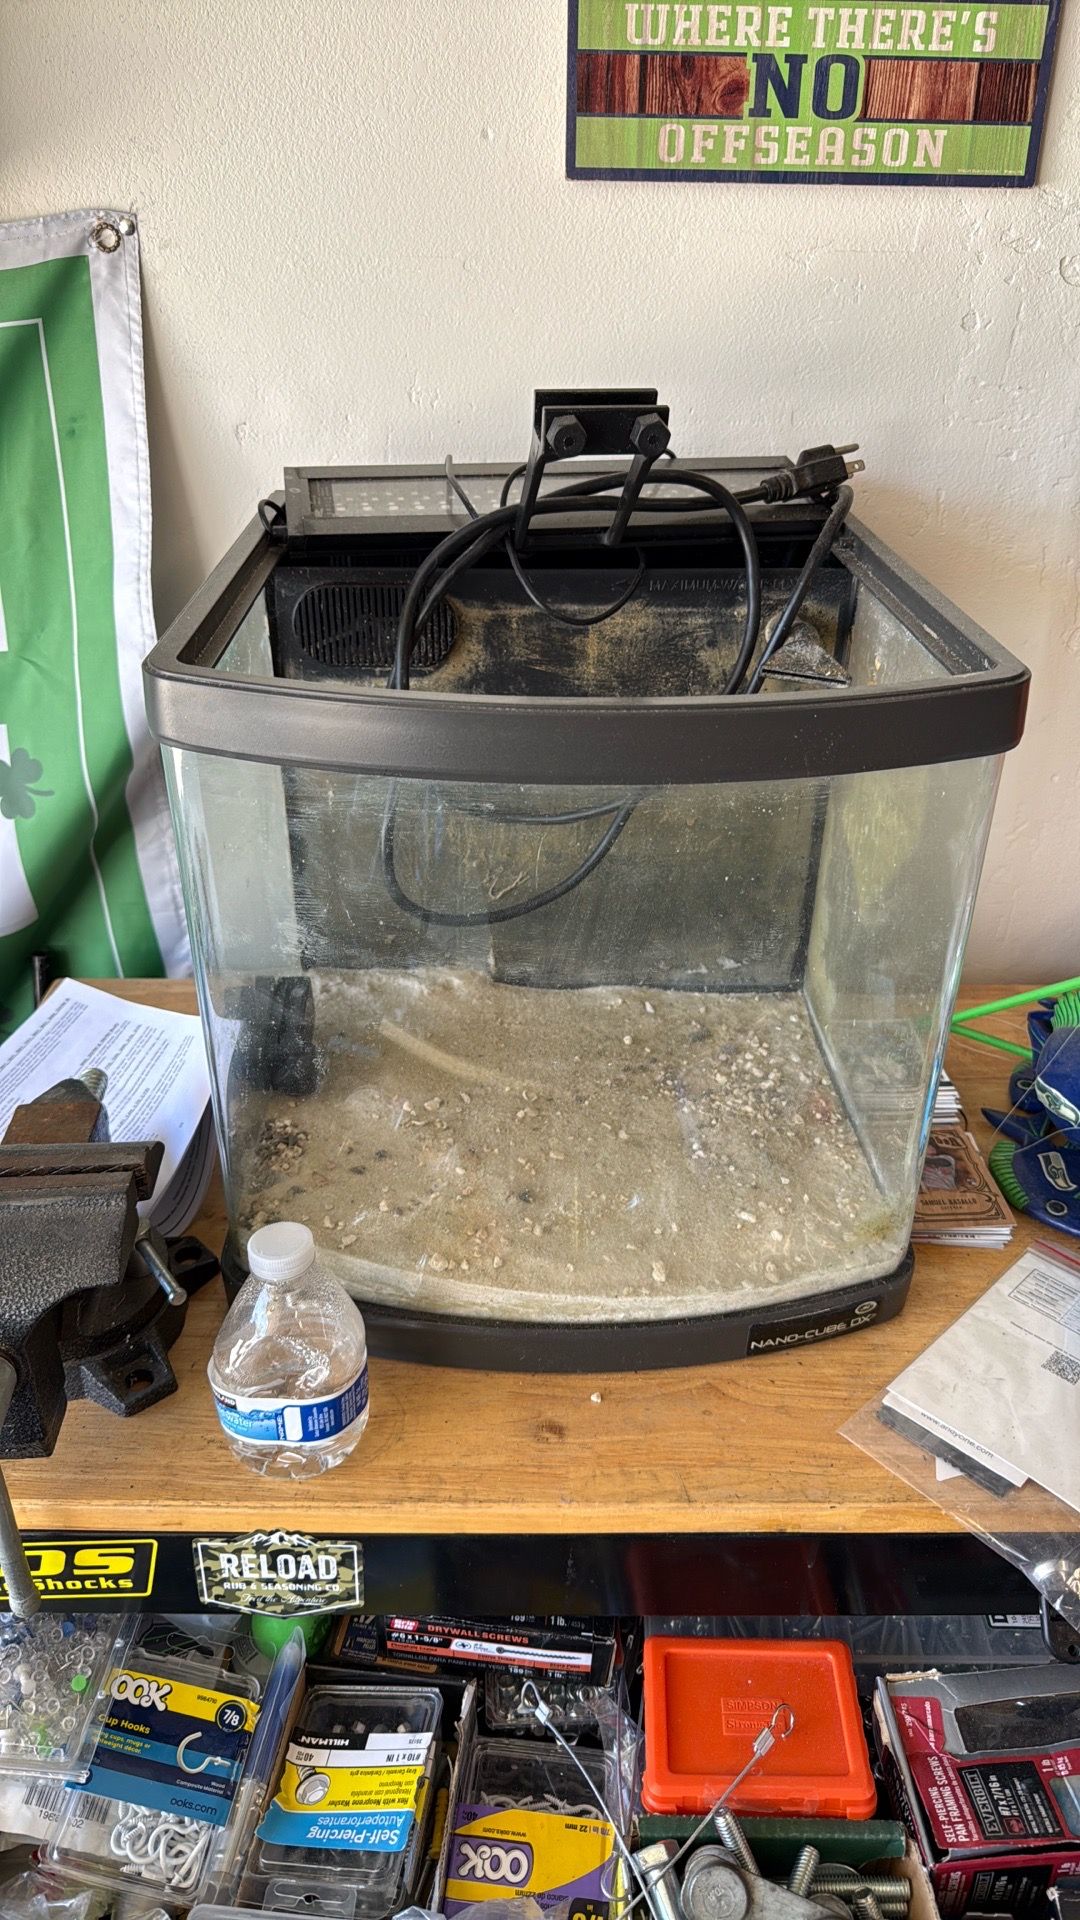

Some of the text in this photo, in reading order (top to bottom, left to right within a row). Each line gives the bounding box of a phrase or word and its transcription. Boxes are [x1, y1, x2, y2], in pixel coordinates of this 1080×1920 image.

[625, 2, 999, 53] WHERE THERE'S
[748, 53, 860, 119] NO
[658, 123, 947, 168] OFFSEASON
[750, 1313, 877, 1350] NANO-CUBE DX
[219, 1553, 338, 1580] RELOAD
[223, 1582, 247, 1591] RUB
[250, 1582, 257, 1591] &
[261, 1583, 322, 1592] SEASONING
[427, 1624, 480, 1637] DRYWALL
[482, 1631, 529, 1644] SCREWS
[110, 1673, 172, 1711] OOK
[98, 1713, 151, 1735] Cup Hooks
[223, 1708, 240, 1726] 7/8
[300, 1735, 350, 1746] HILLMAN
[303, 1752, 315, 1761] 40
[386, 1754, 396, 1762] IN
[407, 1753, 421, 1761] #10
[927, 1756, 970, 1842] PAN FRAMING SCREWS
[988, 1782, 1007, 1800] 7/16
[169, 1795, 218, 1816] ooks.com
[327, 1797, 409, 1808] Hex with Neoprene Washer
[966, 1773, 998, 1832] EVERBILT
[317, 1814, 405, 1828] Autoperforantes
[928, 1787, 957, 1843] SELF-PIERCING
[306, 1826, 401, 1845] Self-Piercing
[482, 1827, 527, 1838] www.ooks.com
[564, 1823, 578, 1831] mm
[579, 1824, 588, 1833] 22
[457, 1841, 529, 1884] OOK
